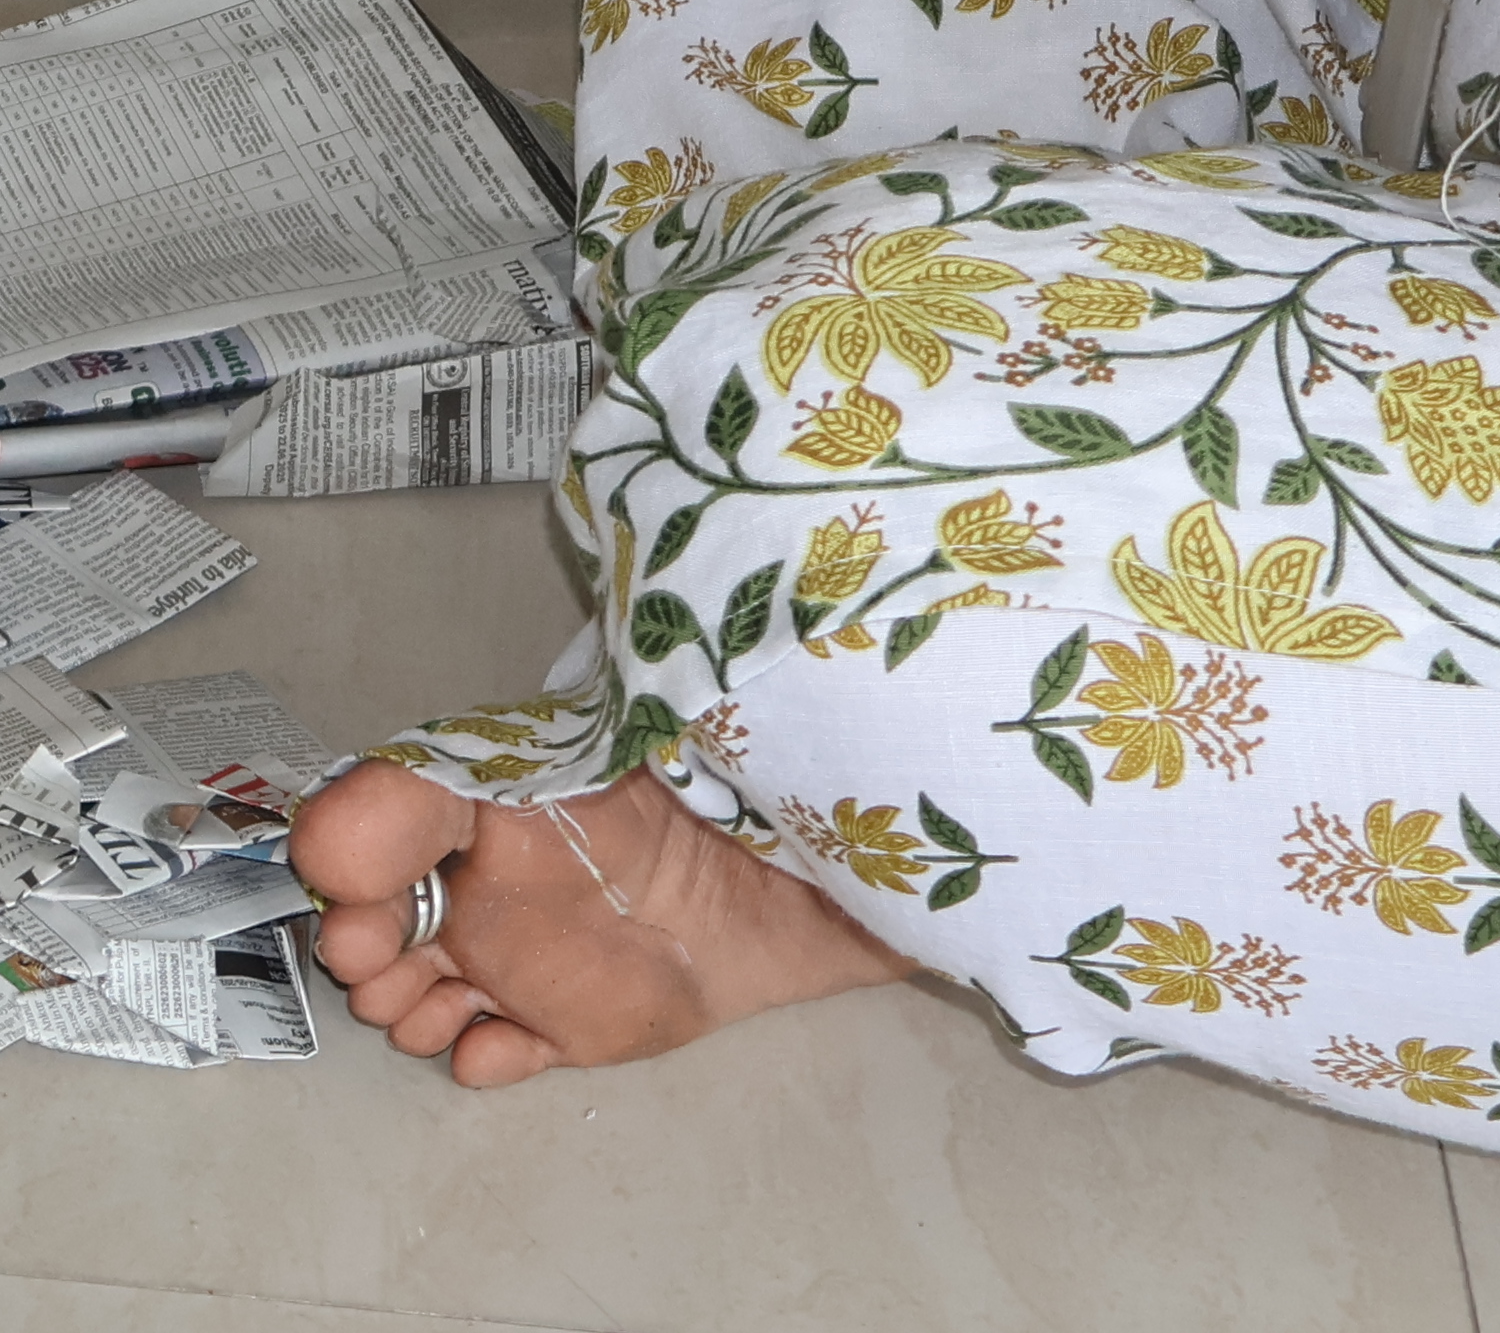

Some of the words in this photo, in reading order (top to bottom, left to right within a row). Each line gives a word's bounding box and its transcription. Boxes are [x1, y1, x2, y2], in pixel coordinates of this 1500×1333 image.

[403, 87, 440, 137] AMENDMENT
[441, 100, 466, 131] SECTION
[447, 434, 460, 468] Security
[199, 561, 225, 586] to
[130, 947, 140, 957] of
[185, 959, 194, 970] be
[185, 974, 195, 988] will
[199, 1017, 210, 1044] Terms
